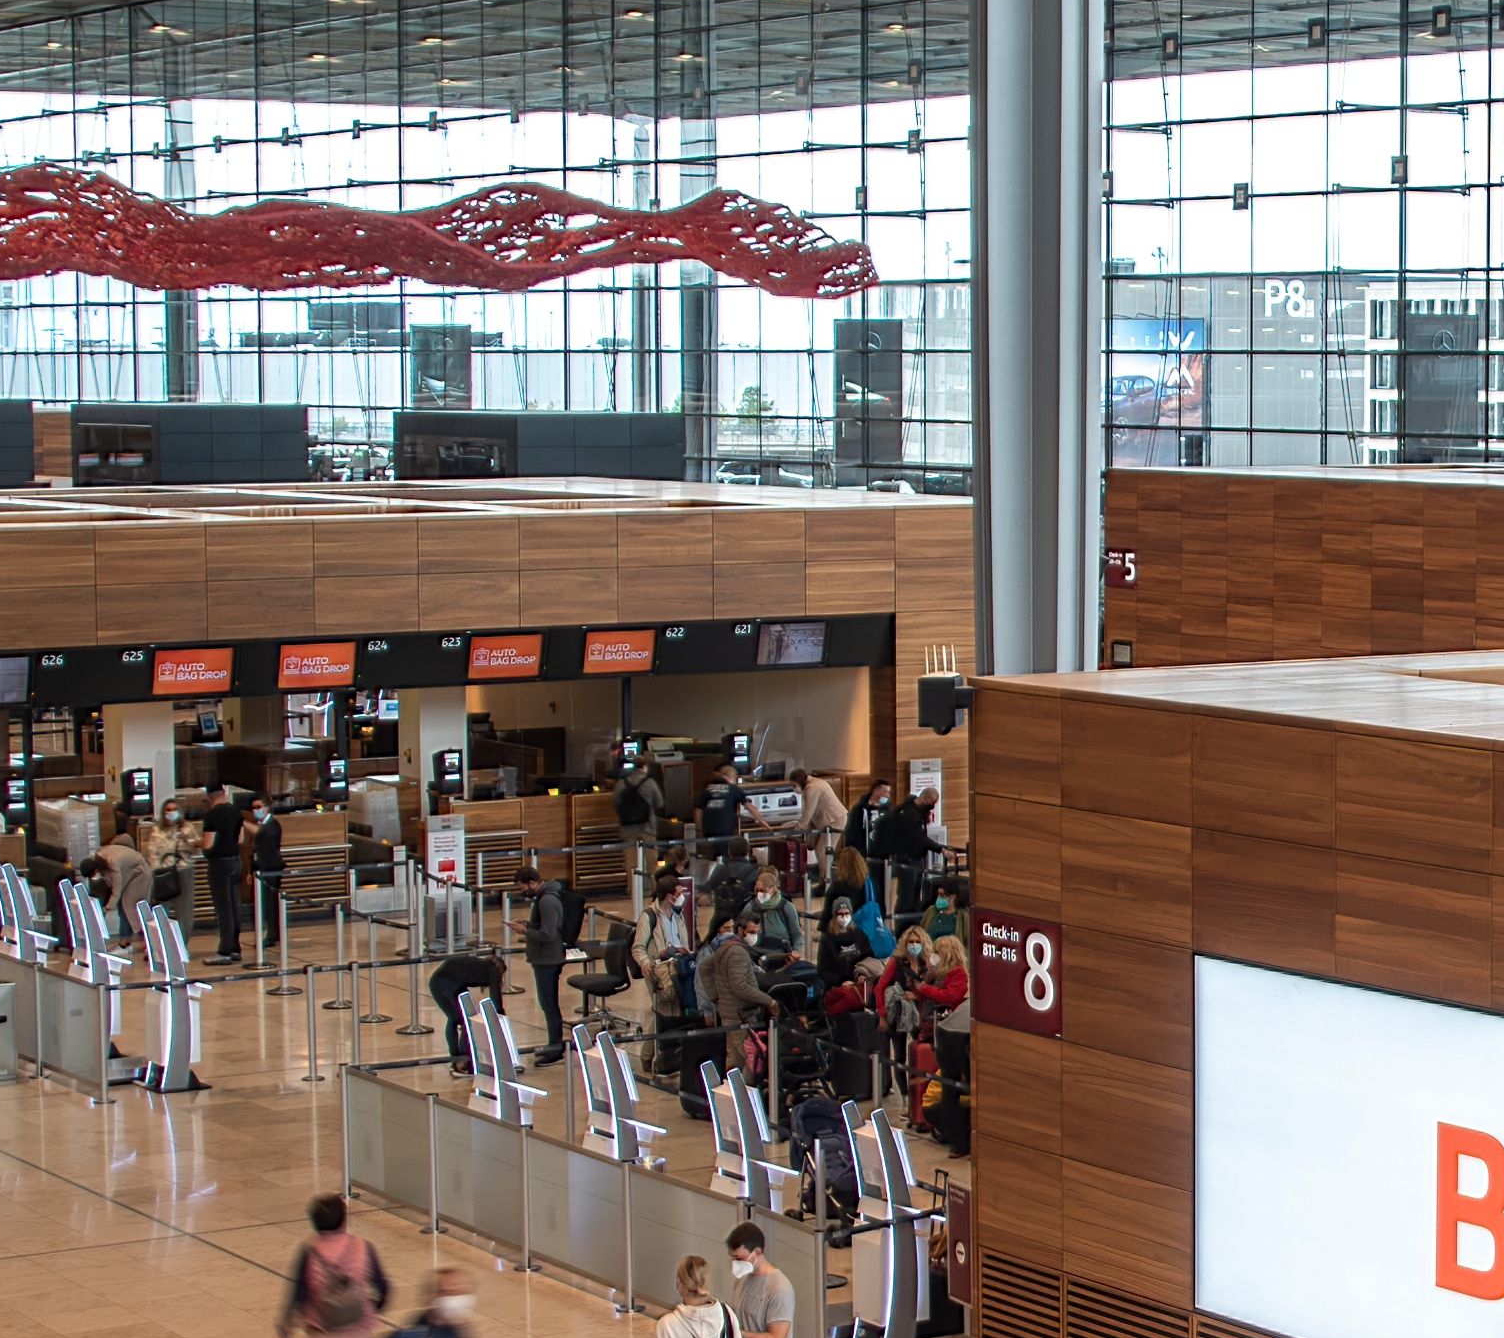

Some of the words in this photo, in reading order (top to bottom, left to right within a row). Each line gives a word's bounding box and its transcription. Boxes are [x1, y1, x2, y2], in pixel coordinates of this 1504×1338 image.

[1125, 552, 1135, 581] 5
[665, 627, 684, 638] 622
[734, 624, 751, 635] 621
[367, 640, 387, 651] 624
[441, 636, 461, 648] 623
[605, 643, 630, 652] AUTO
[122, 650, 144, 662] 625
[491, 648, 516, 657] AUTO
[604, 652, 624, 660] BAG
[625, 651, 649, 660] DROP
[41, 654, 63, 666] 626
[302, 657, 329, 666] AUTO
[490, 657, 510, 666] BAG
[511, 656, 536, 664] DROP
[177, 662, 205, 672] AUTO
[301, 665, 322, 674] BAG
[323, 663, 350, 673] DROP
[176, 672, 197, 681] BAG
[199, 670, 227, 680] DROP
[982, 922, 1019, 942] Check-in
[982, 942, 1017, 962] 811–816
[1023, 932, 1054, 1011] 8
